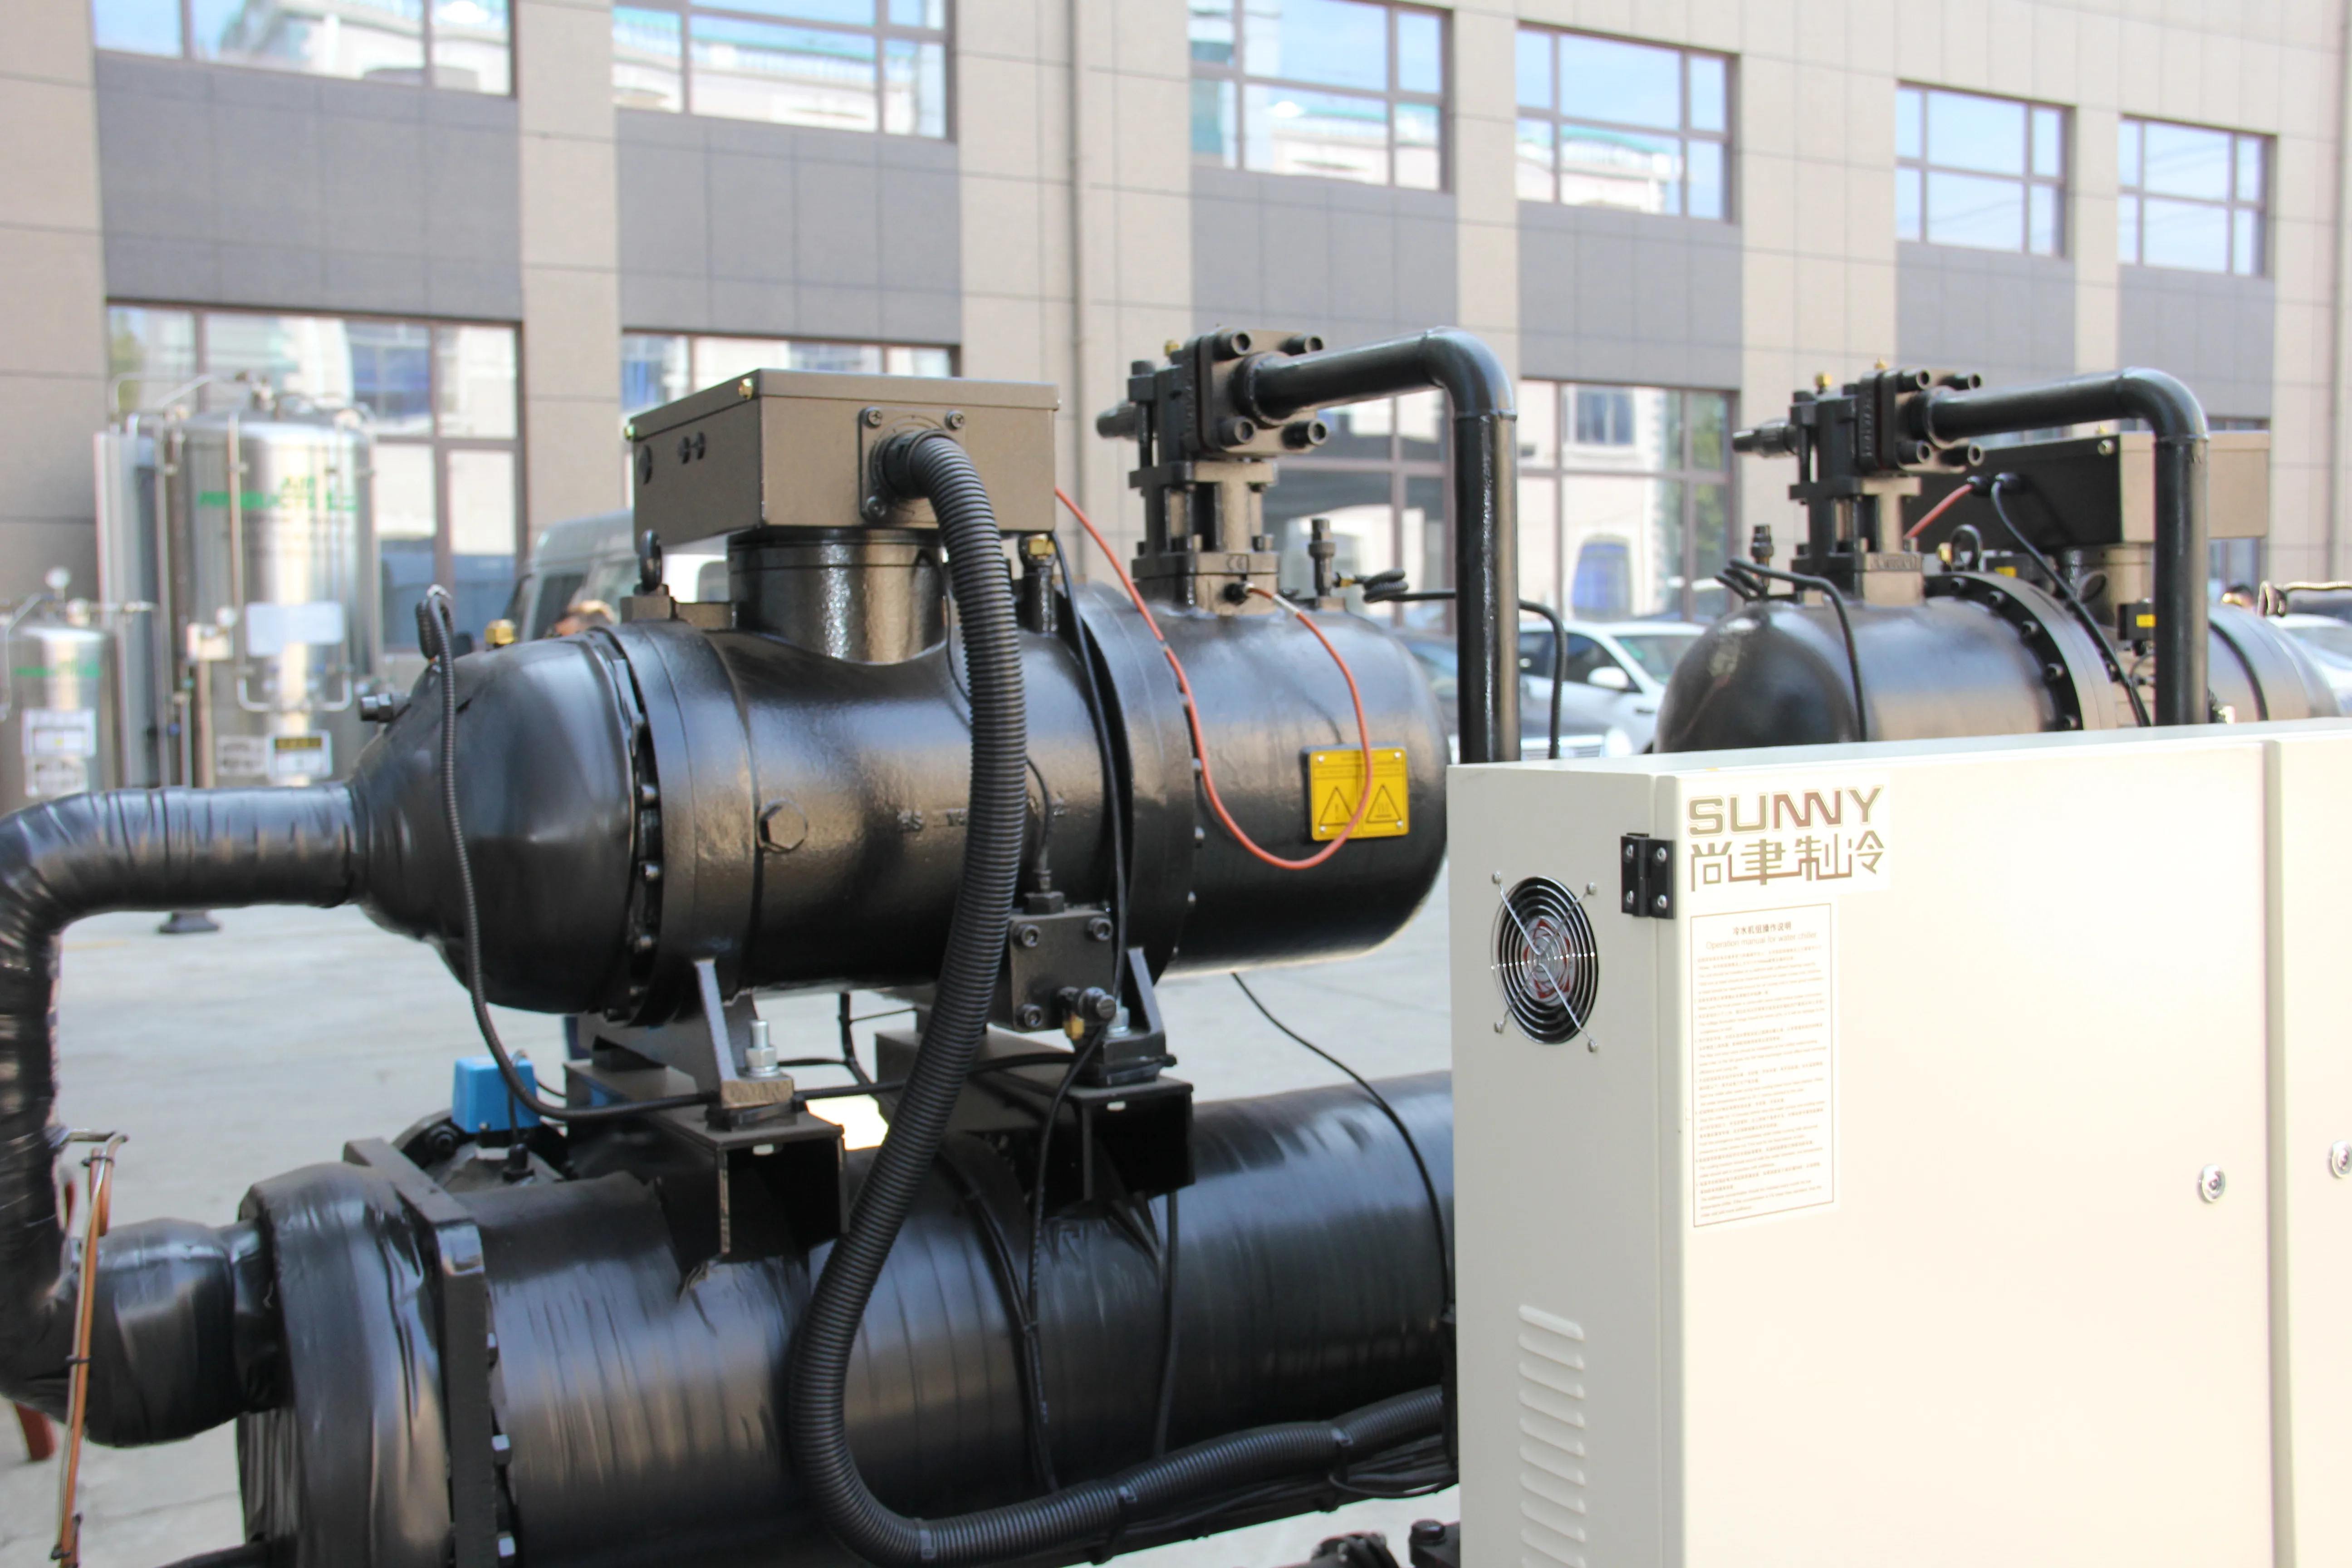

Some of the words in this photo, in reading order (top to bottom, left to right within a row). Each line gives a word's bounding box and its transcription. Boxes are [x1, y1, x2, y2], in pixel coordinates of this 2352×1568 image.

[1688, 786, 1882, 835] SUNNY
[1733, 921, 1792, 936] 冷水机组操作说明
[1706, 940, 1740, 951] Operation
[1741, 937, 1766, 946] manual
[1767, 935, 1776, 943] for
[1778, 934, 1796, 942] water
[1798, 931, 1817, 940] chiller
